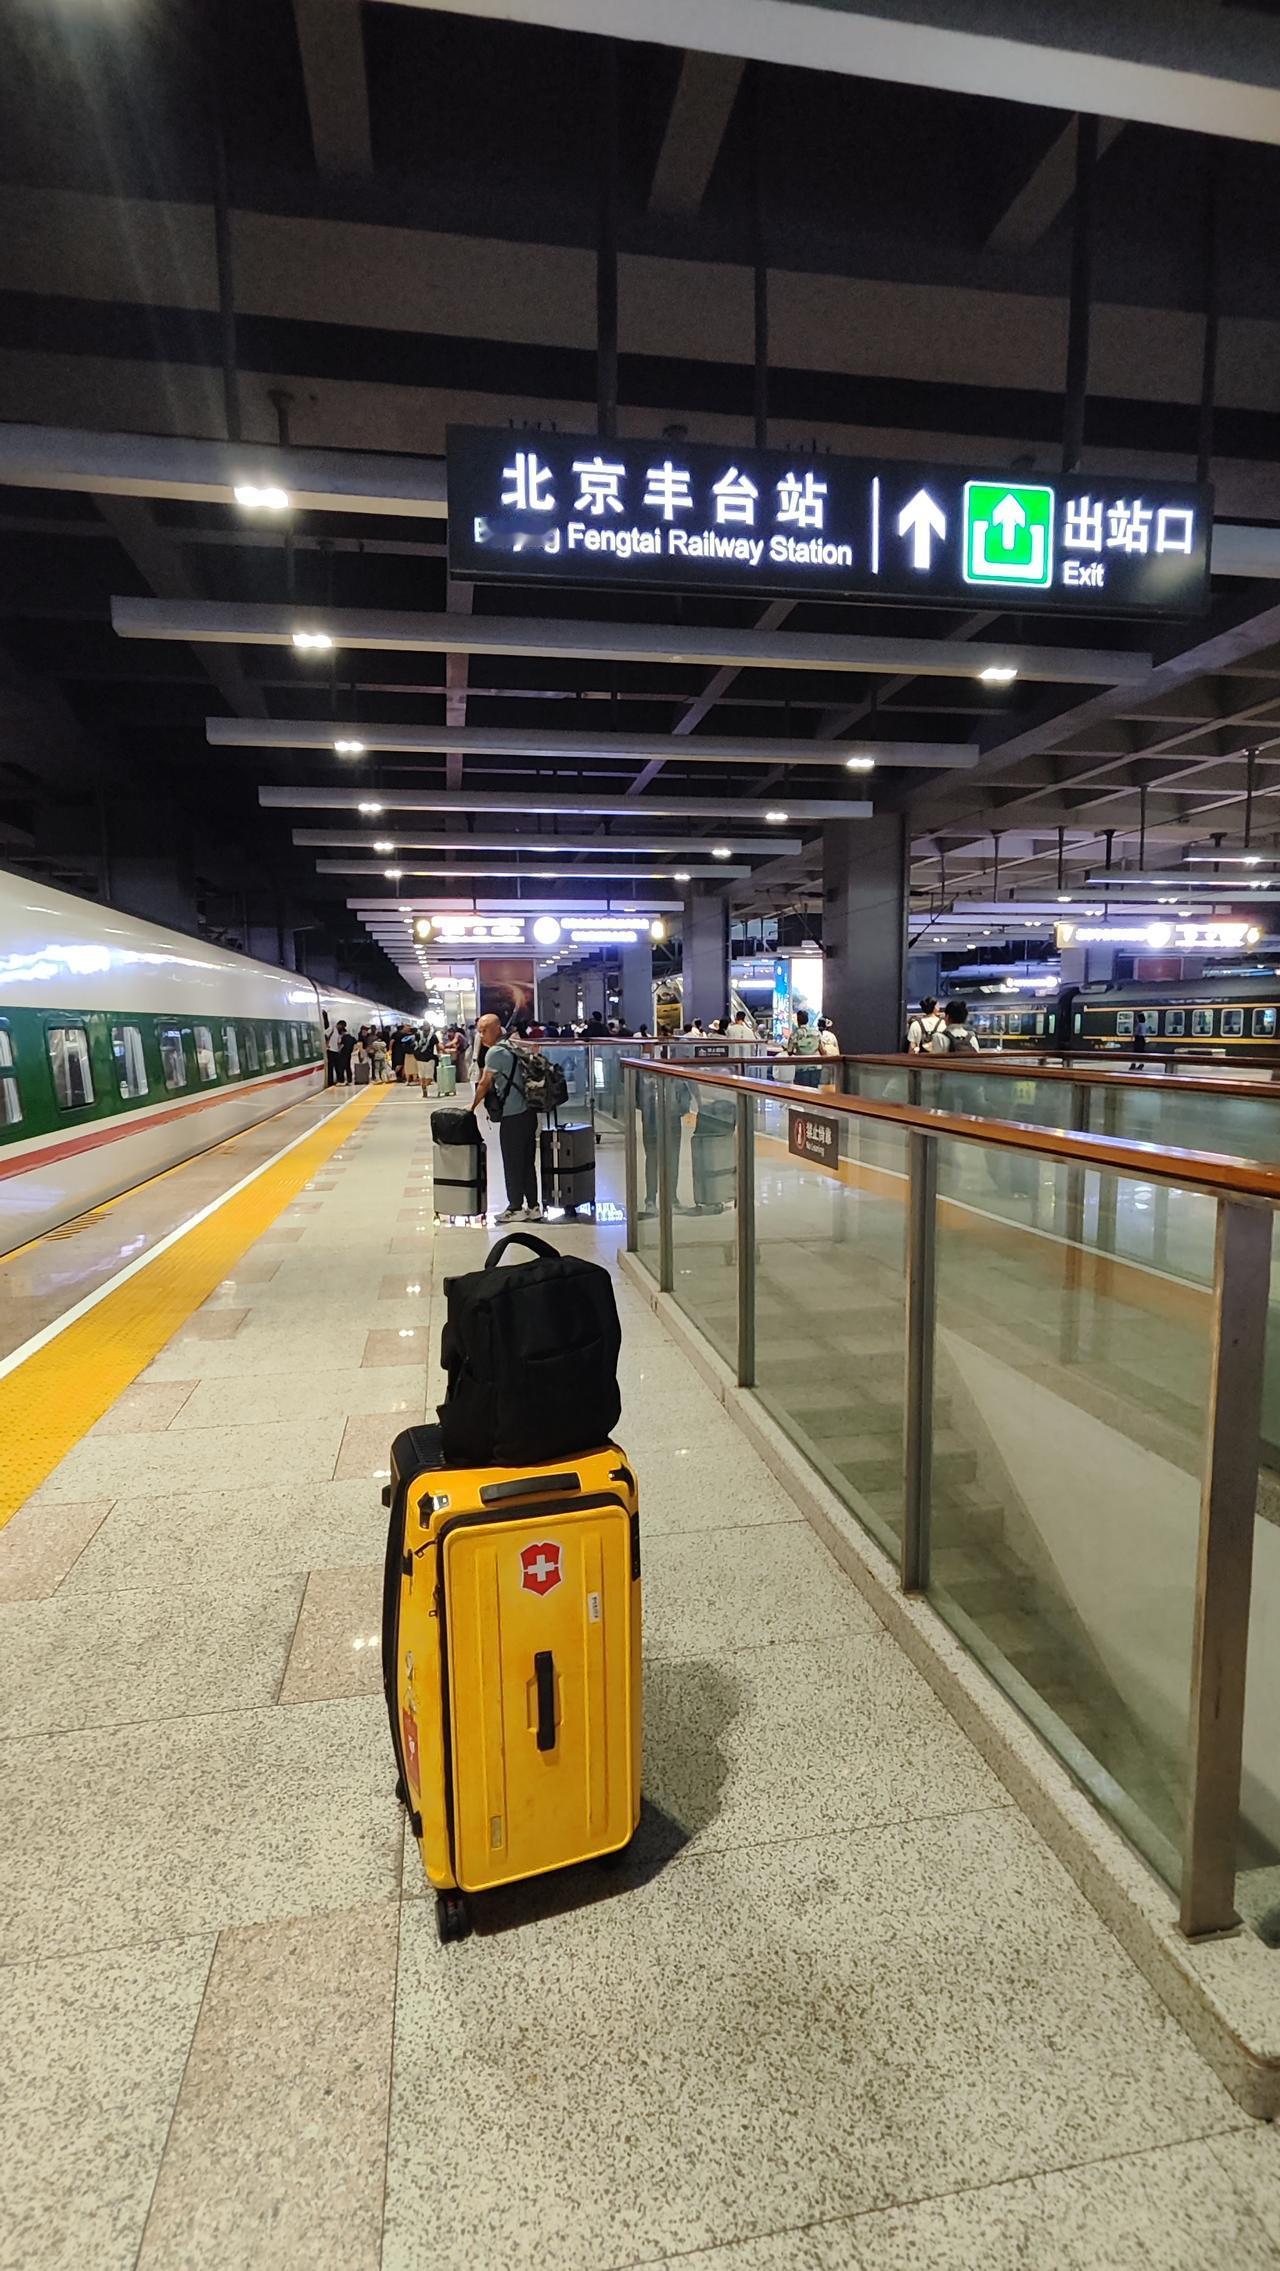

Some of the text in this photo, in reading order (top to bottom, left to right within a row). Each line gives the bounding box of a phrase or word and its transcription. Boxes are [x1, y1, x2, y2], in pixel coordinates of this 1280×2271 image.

[500, 452, 828, 528] 北京丰台站
[567, 521, 662, 558] Fengtai
[668, 530, 765, 566] Railway
[769, 534, 853, 566] Station
[1063, 496, 1194, 555] 出站口
[1062, 560, 1105, 587] Exit
